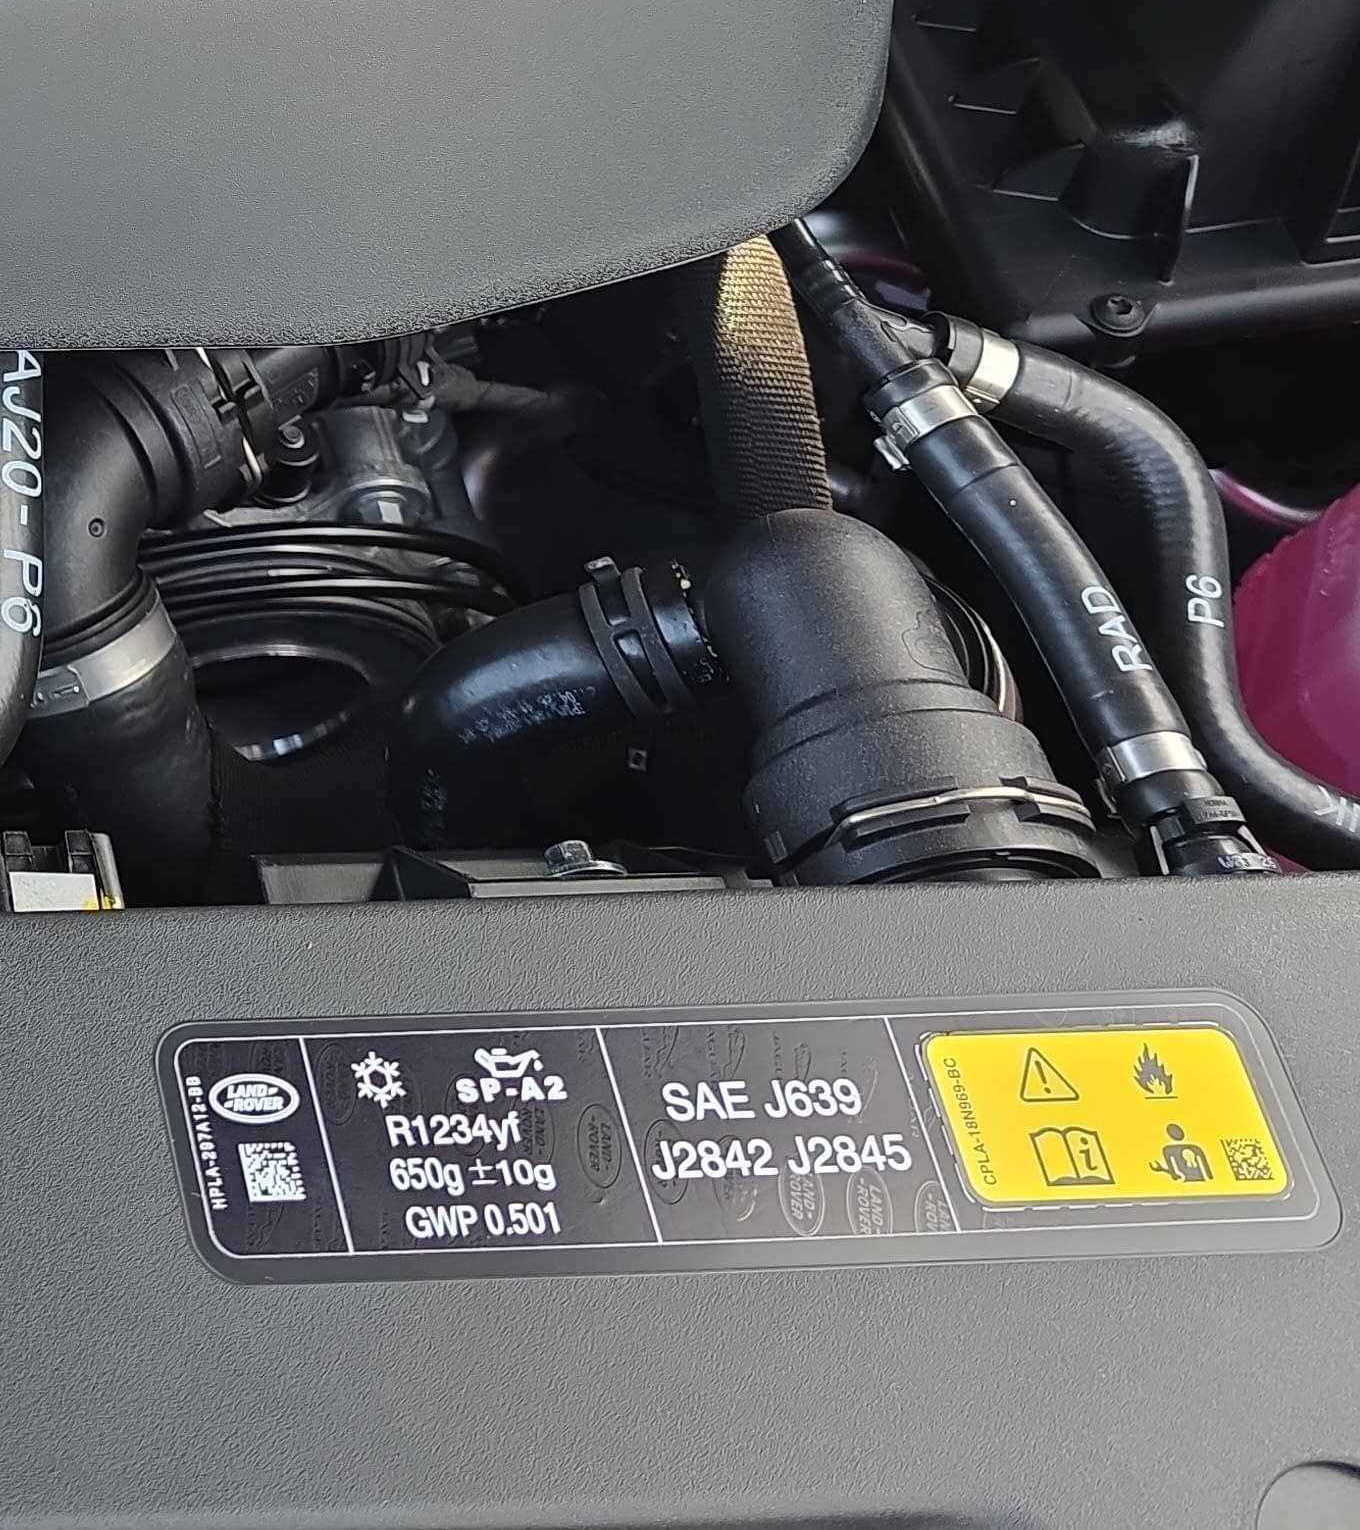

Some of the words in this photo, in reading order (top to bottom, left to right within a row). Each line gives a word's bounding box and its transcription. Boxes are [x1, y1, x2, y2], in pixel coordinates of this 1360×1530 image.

[1, 549, 43, 637] P6
[1185, 574, 1225, 628] P6
[1081, 585, 1154, 672] RAD
[227, 1083, 269, 1099] LAND
[232, 1096, 284, 1113] ROVER
[455, 1075, 568, 1103] SP-A2
[661, 1080, 756, 1121] SAE
[763, 1078, 862, 1119] J639
[384, 1110, 523, 1152] R1234yf
[943, 1057, 997, 1186] CPLA-18N969-BC
[389, 1157, 465, 1197] 650g
[468, 1158, 557, 1191] ±10g
[651, 1139, 779, 1180] J2842
[787, 1134, 913, 1176] J2845
[405, 1205, 478, 1239] GWP
[483, 1201, 561, 1237] 0.501
